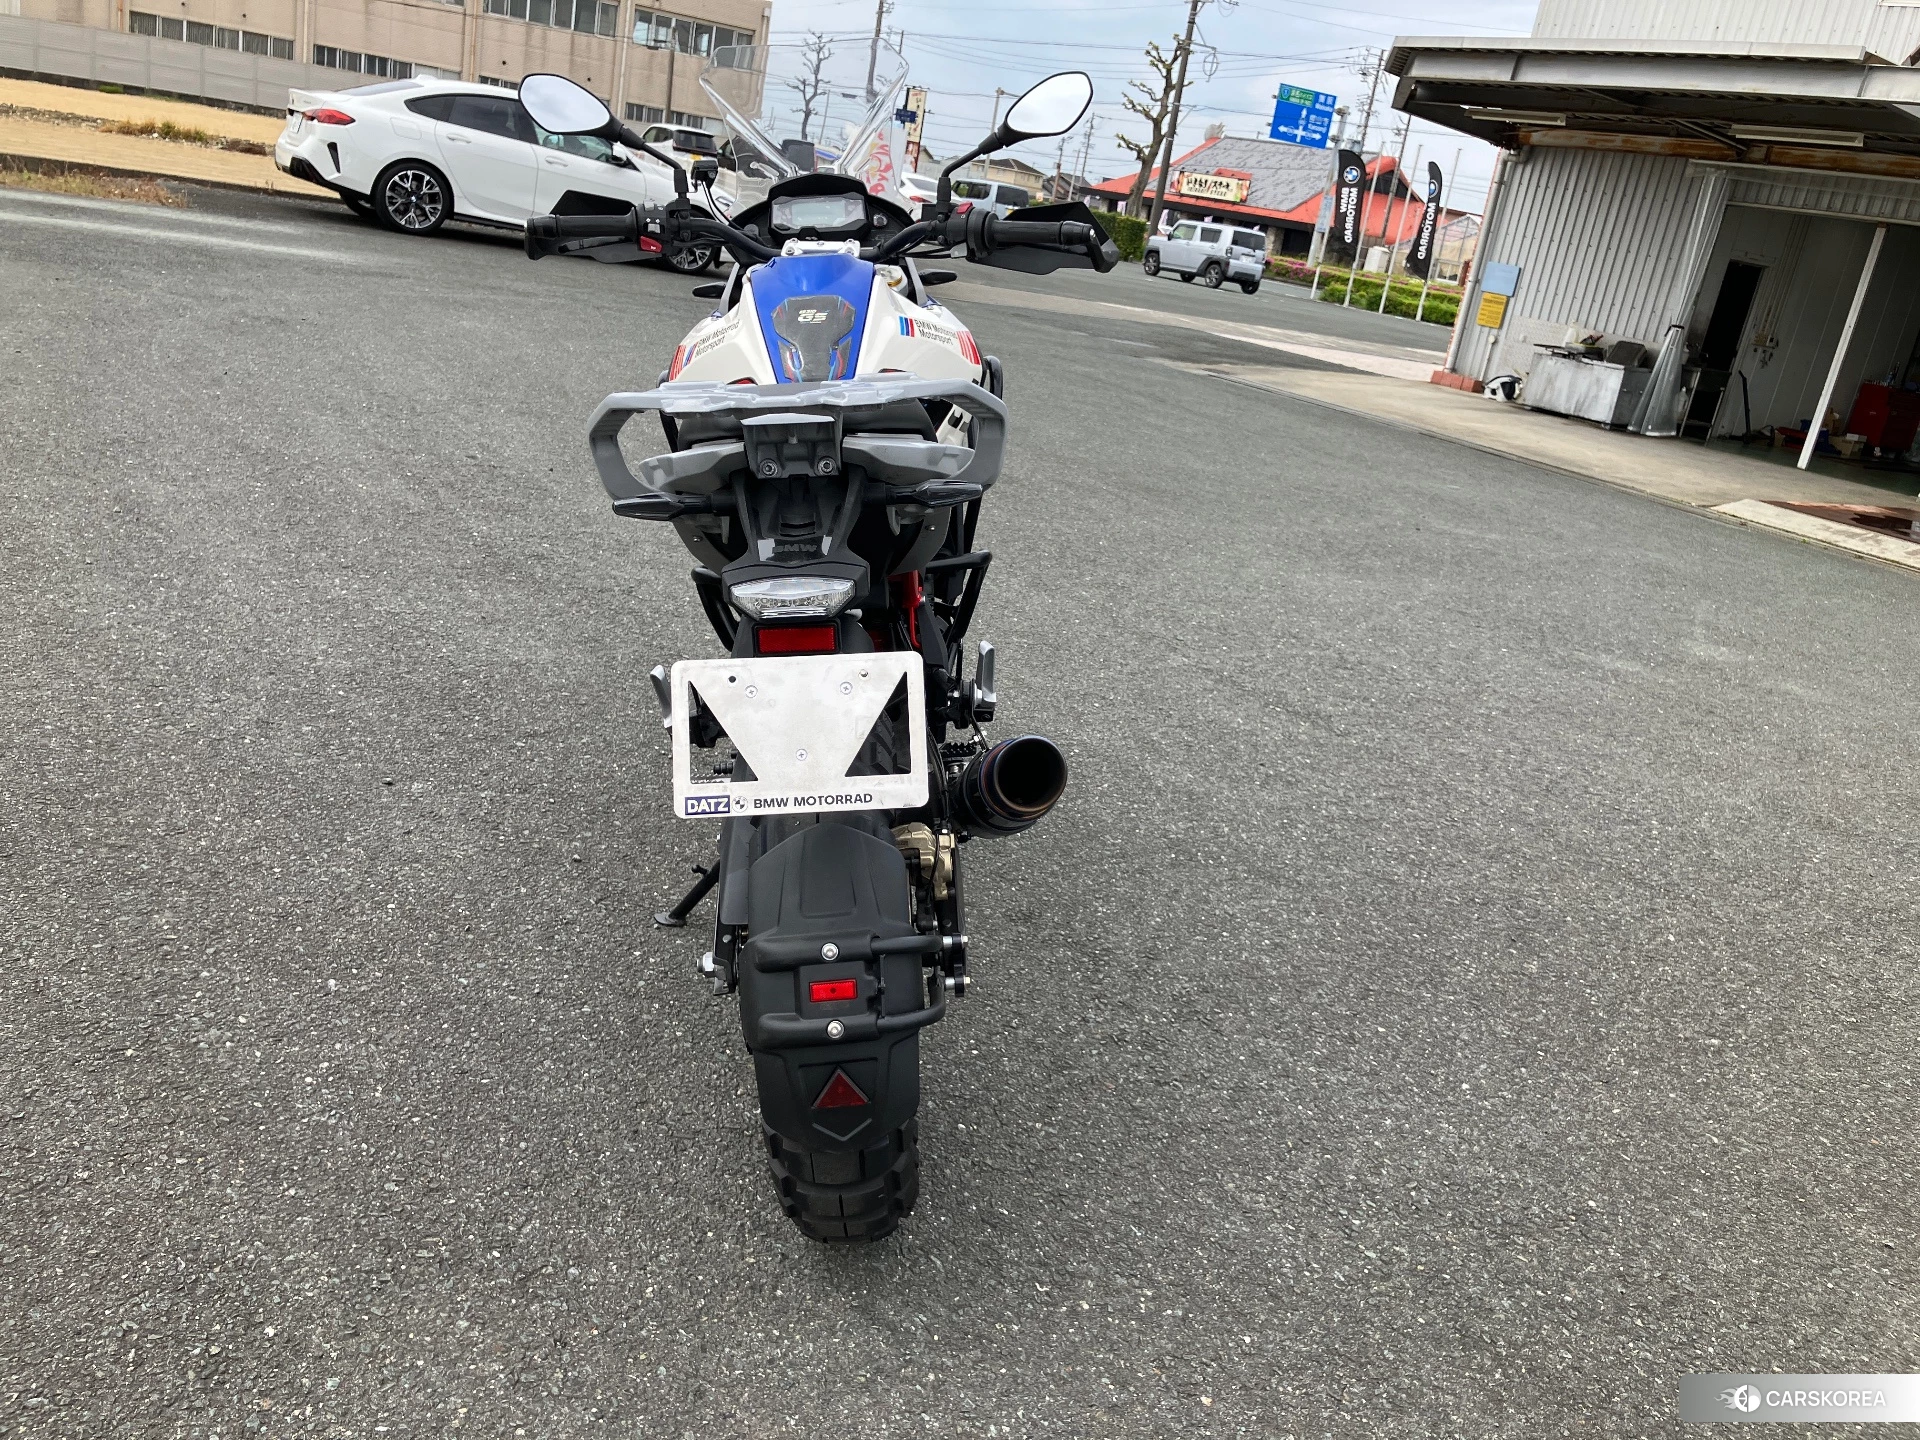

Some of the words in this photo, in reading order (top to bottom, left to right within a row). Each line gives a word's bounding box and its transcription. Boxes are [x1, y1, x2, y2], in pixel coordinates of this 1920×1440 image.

[687, 798, 729, 814] DATZ
[753, 797, 789, 809] BMW
[793, 793, 873, 807] MOTORRAD
